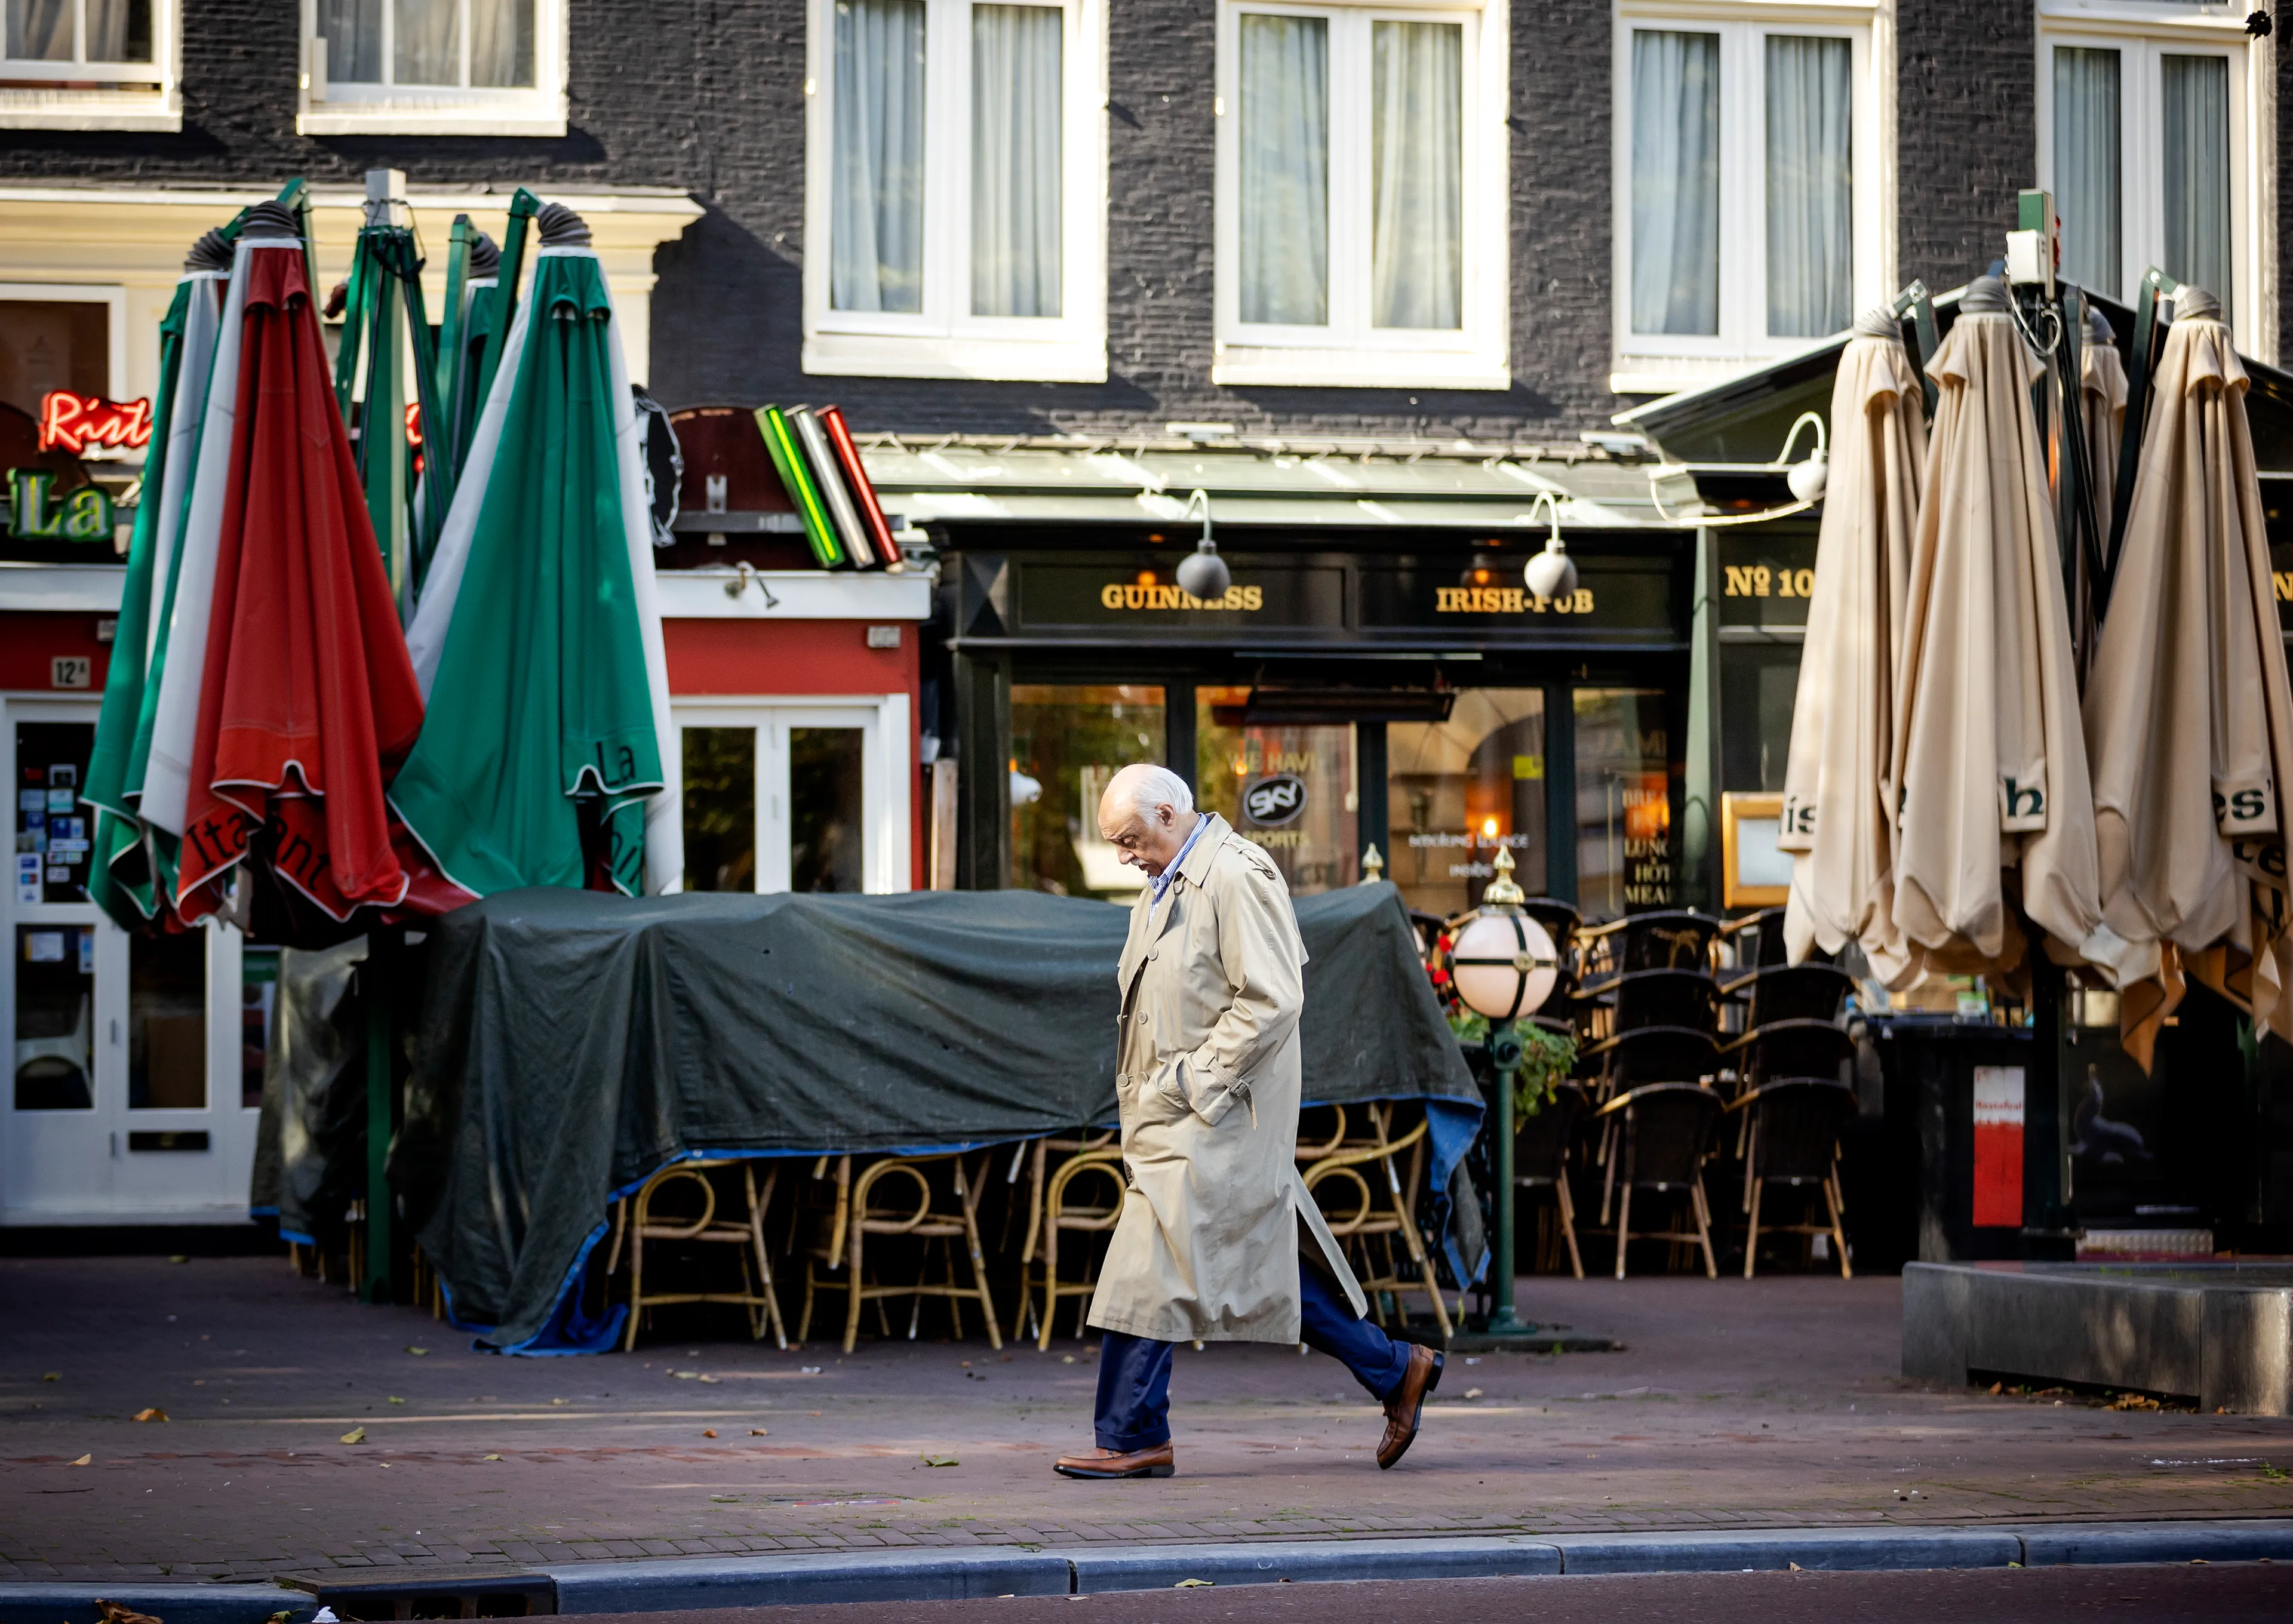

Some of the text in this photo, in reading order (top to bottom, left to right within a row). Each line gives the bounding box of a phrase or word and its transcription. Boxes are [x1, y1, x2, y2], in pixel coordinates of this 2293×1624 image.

[43, 391, 153, 453] Rist
[12, 469, 113, 539] La
[595, 742, 635, 786] La
[186, 813, 246, 871] Ita
